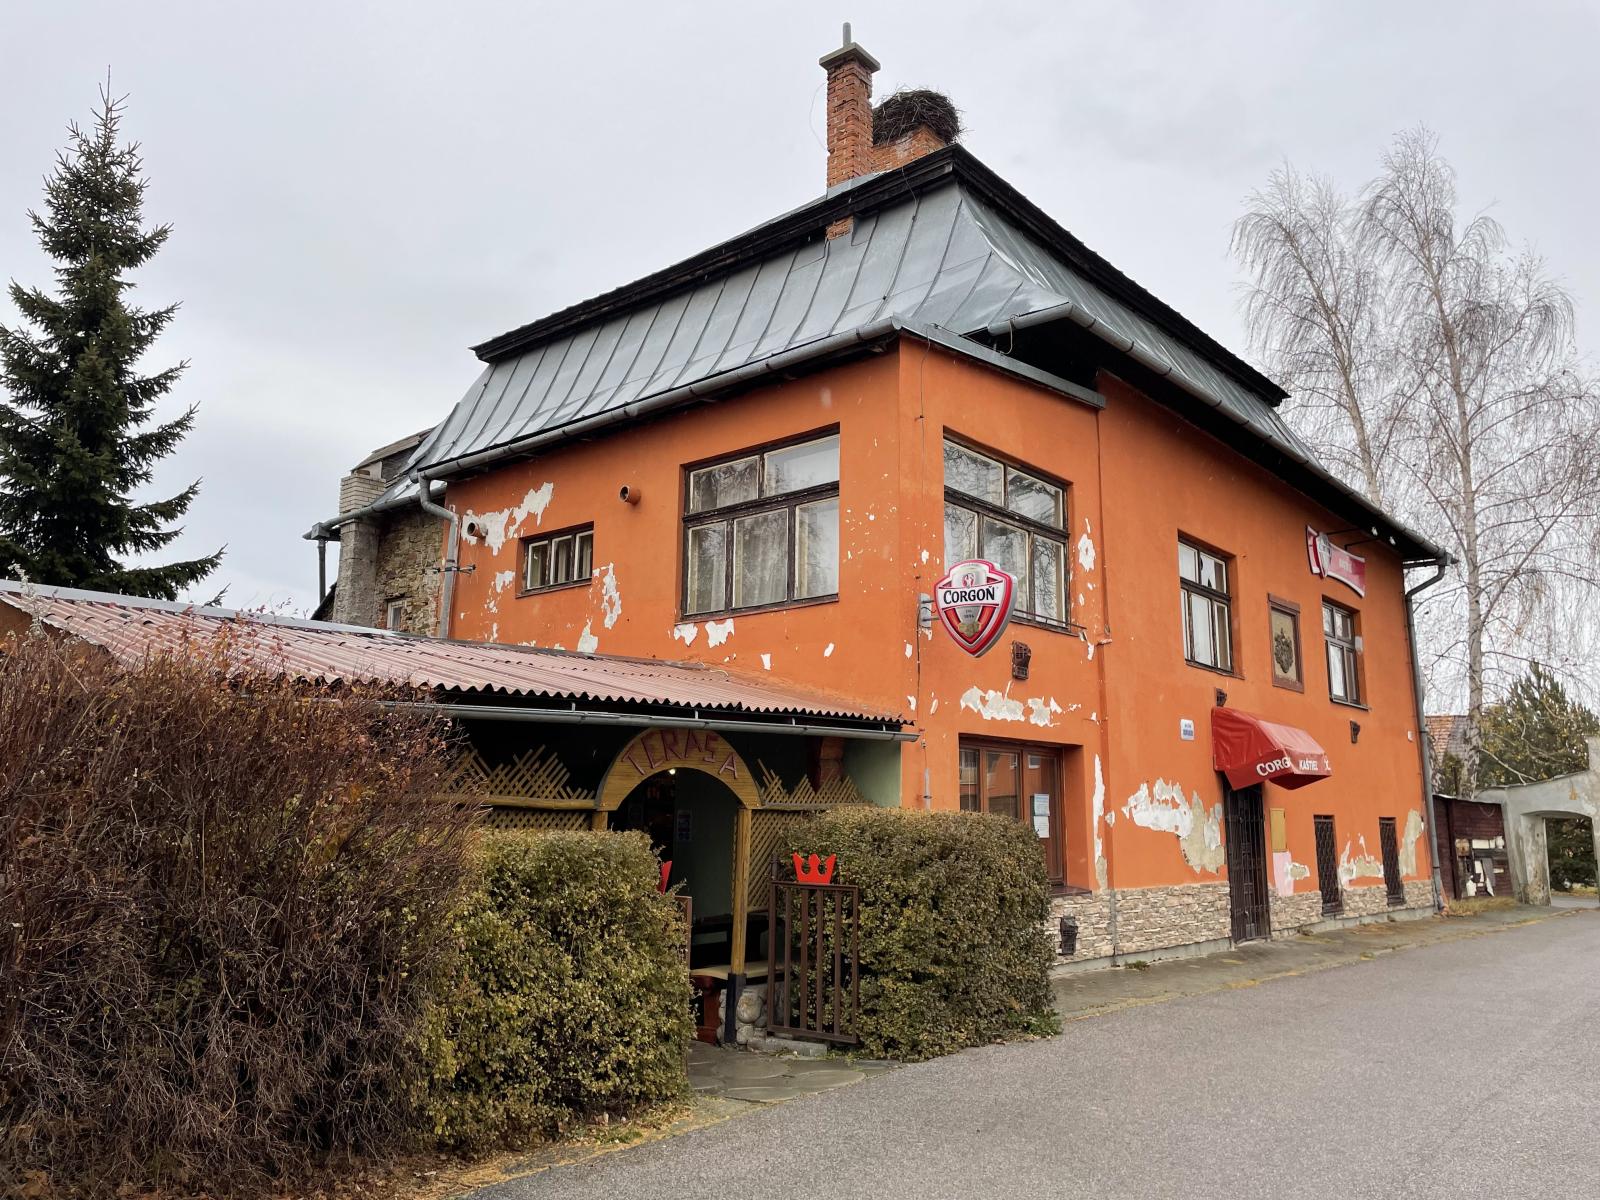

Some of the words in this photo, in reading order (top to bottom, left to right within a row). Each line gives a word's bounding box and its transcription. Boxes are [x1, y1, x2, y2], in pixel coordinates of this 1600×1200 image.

[943, 585, 995, 604] CORGOŇ
[621, 728, 738, 779] TERASA
[1256, 756, 1291, 777] CORG
